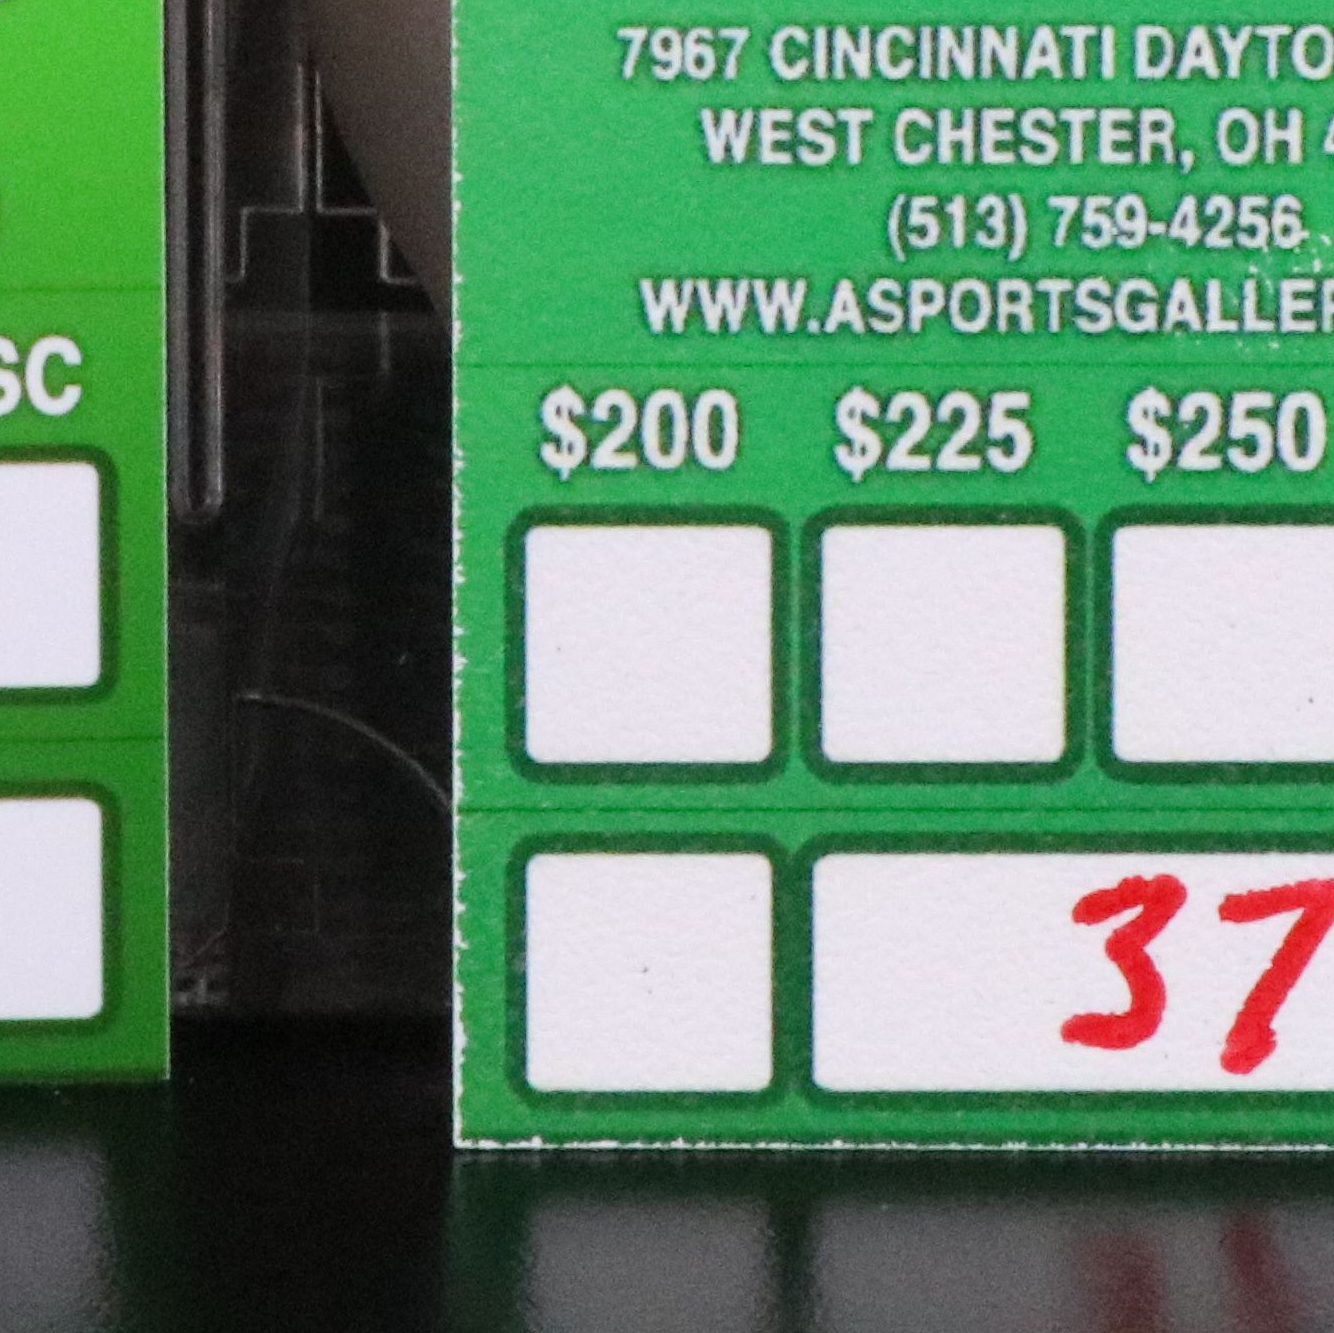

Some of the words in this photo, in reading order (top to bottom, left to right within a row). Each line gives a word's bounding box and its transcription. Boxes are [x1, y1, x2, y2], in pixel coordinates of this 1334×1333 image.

[617, 26, 750, 81] 7967
[770, 25, 1115, 81] CINCINNATI
[700, 108, 874, 166] WEST
[894, 107, 1195, 173] CHESTER,
[1216, 107, 1304, 165] OH
[887, 193, 1029, 261] (513)
[1048, 193, 1305, 252] 759-4256
[539, 385, 741, 481] $200
[833, 385, 1035, 482] $225
[1125, 385, 1329, 482] $250
